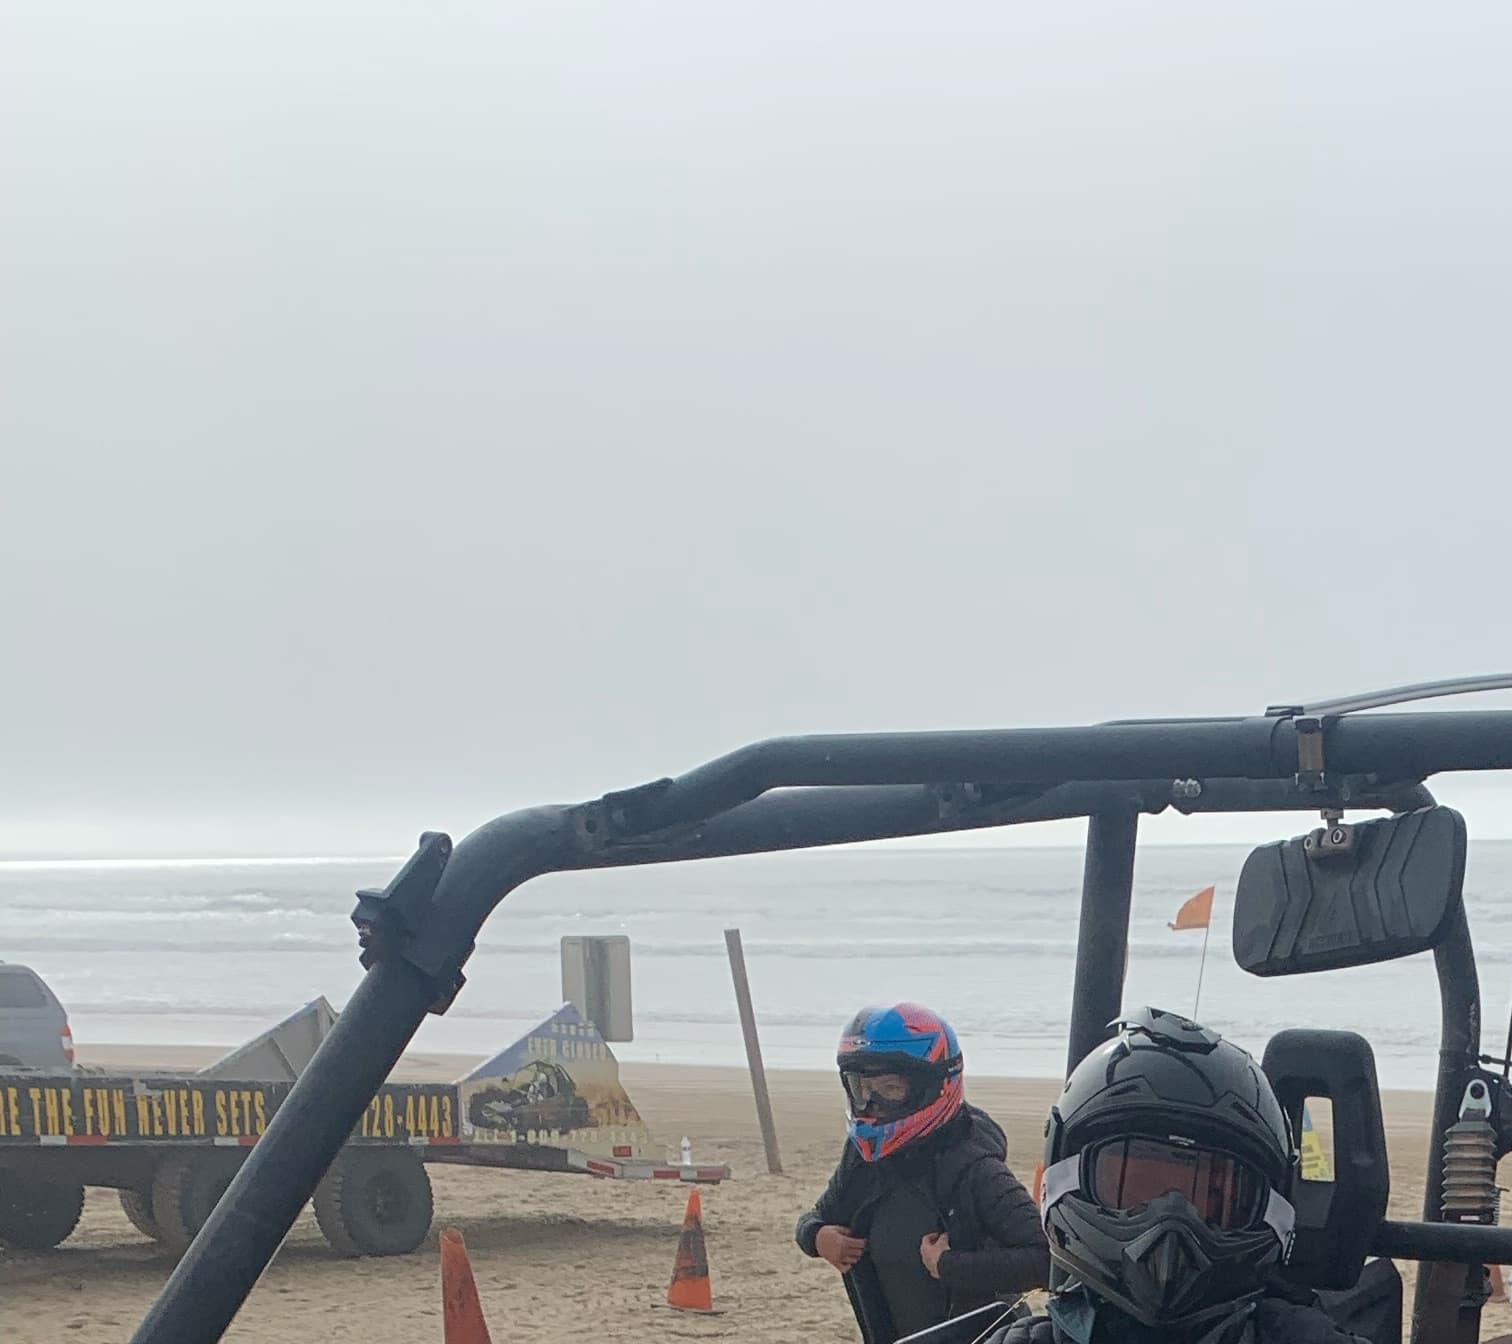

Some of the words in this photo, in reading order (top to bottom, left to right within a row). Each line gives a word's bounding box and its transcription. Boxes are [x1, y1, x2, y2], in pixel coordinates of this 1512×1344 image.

[29, 1088, 74, 1136] THE
[83, 1088, 127, 1136] FUN
[135, 1089, 206, 1136] NEVER
[215, 1089, 267, 1136] SETS
